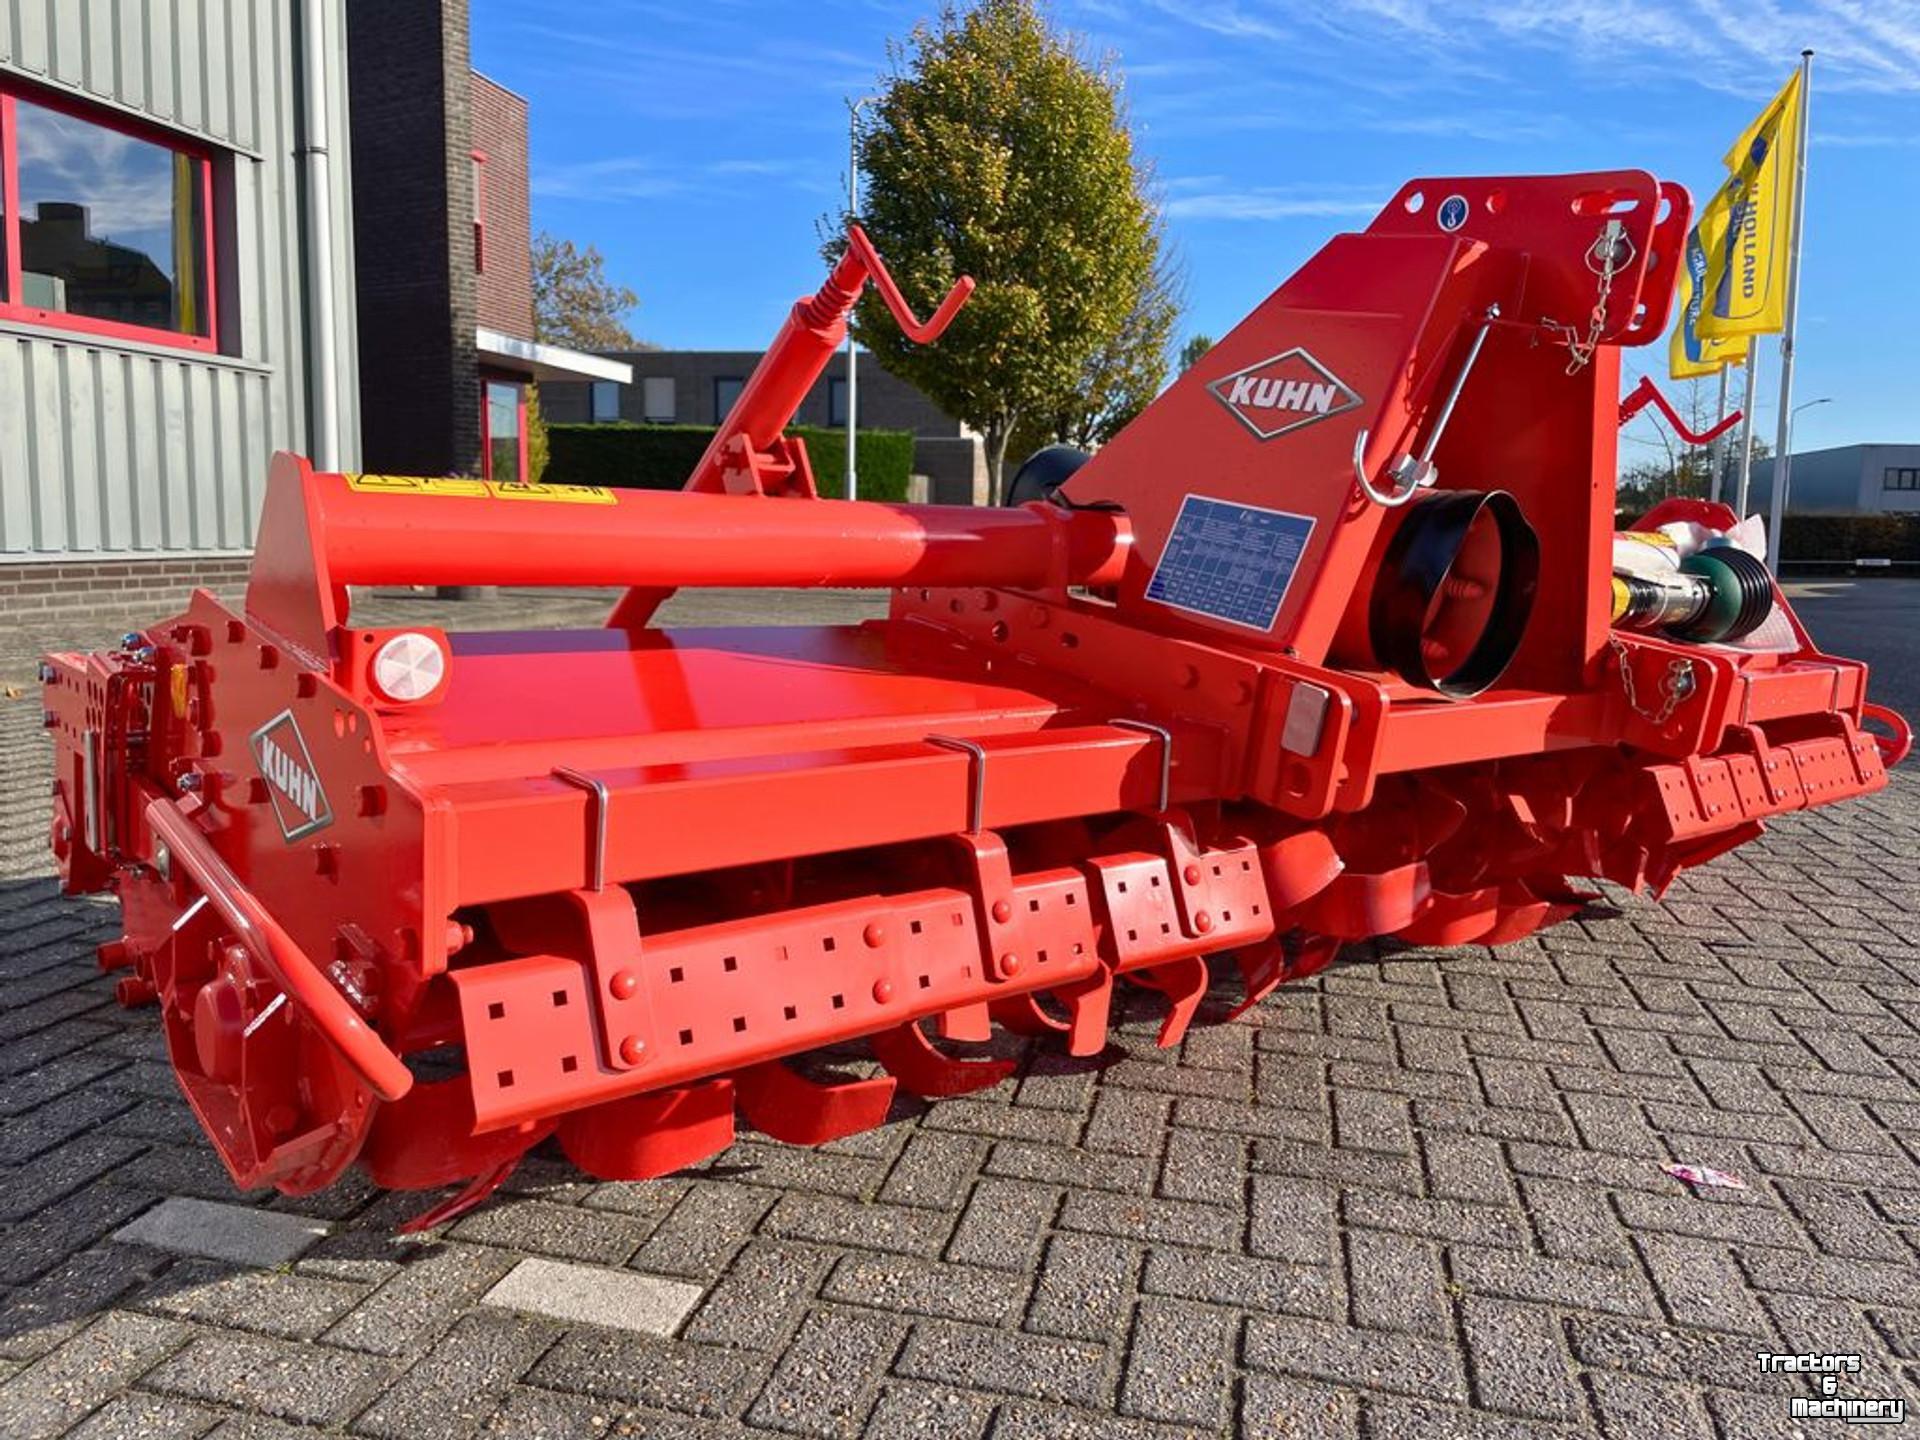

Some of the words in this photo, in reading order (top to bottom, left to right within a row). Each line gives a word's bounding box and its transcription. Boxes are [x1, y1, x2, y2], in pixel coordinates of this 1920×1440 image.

[1743, 200, 1758, 299] HOLLAND
[1228, 376, 1337, 414] KUHN
[261, 734, 318, 824] KUHN
